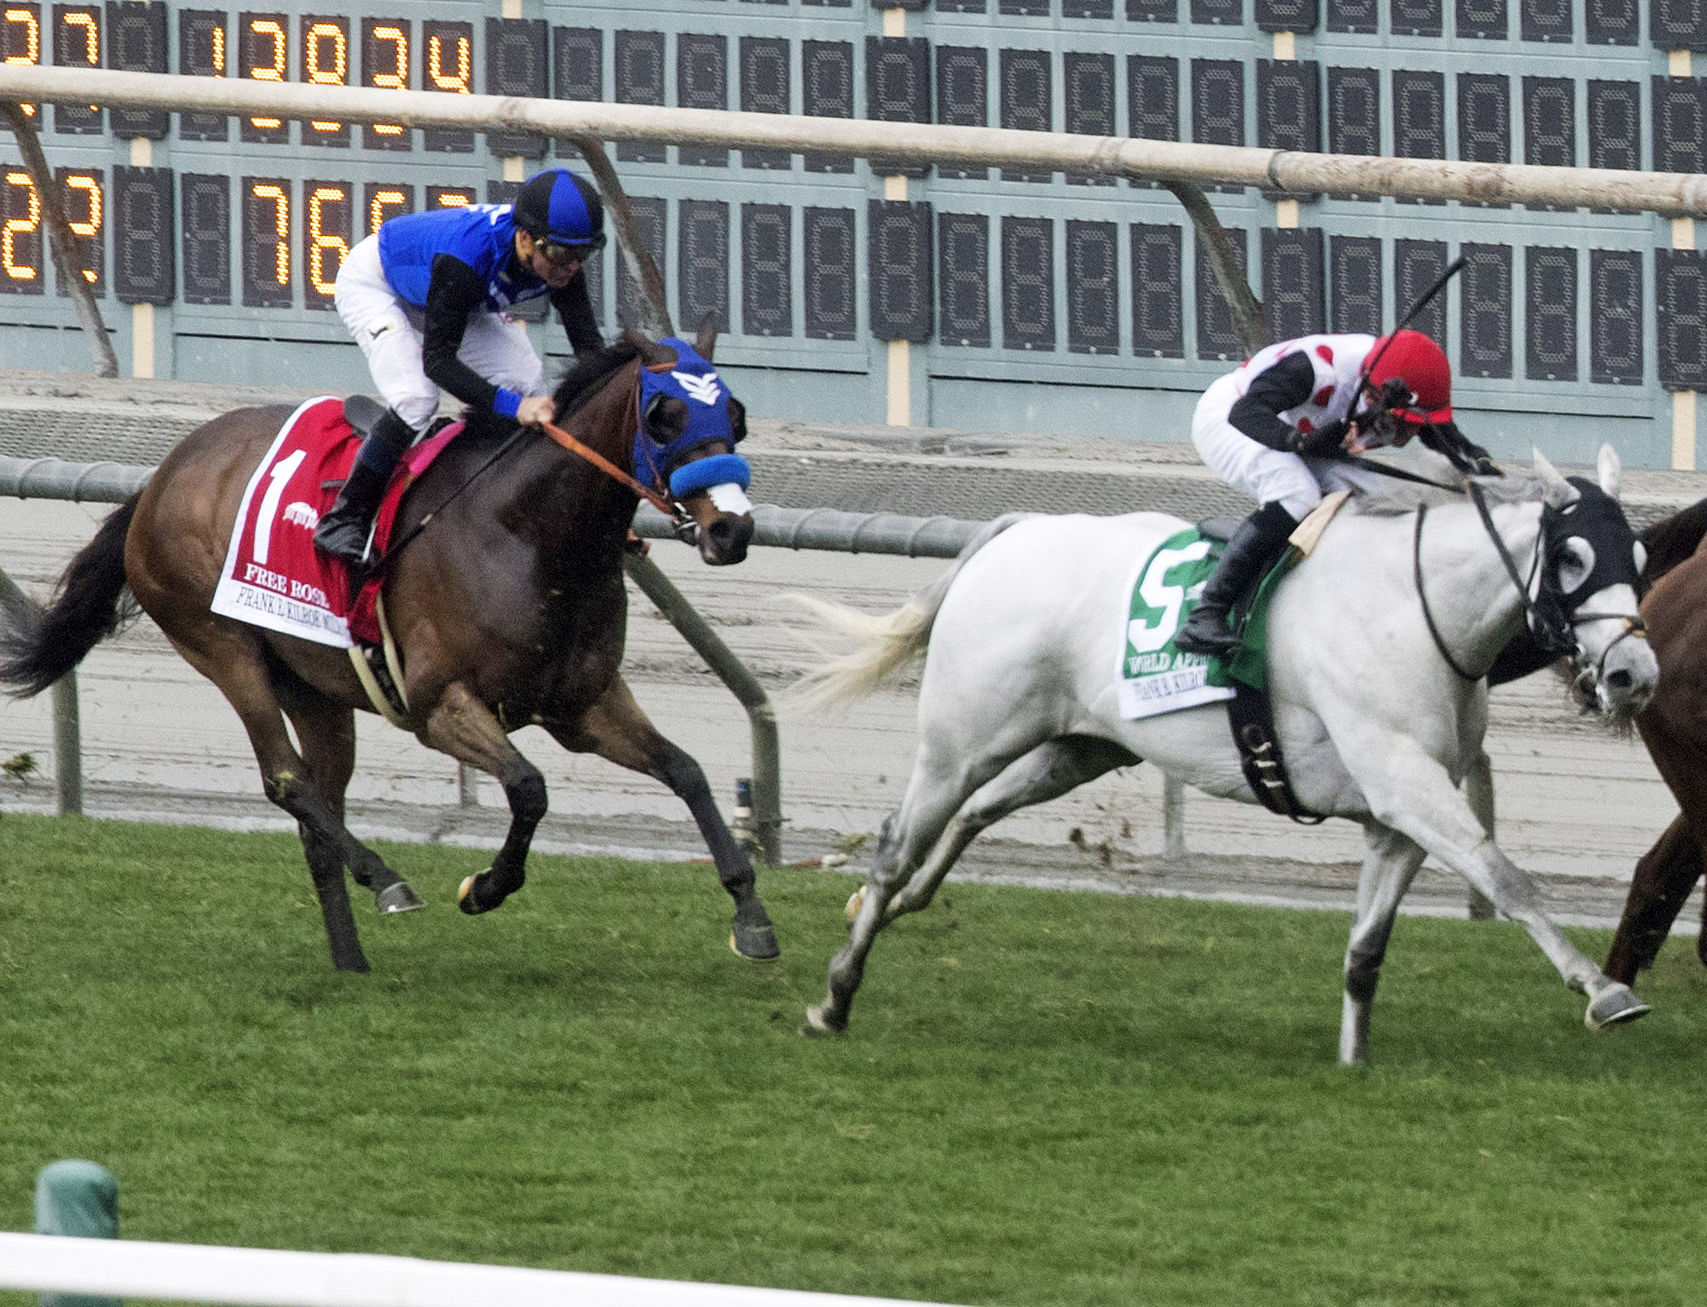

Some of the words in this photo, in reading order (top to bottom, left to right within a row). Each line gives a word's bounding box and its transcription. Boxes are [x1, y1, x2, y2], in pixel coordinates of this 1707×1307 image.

[253, 449, 307, 565] 1
[236, 586, 275, 615] FRANK
[244, 563, 288, 591] FREE
[1128, 541, 1212, 653] 5
